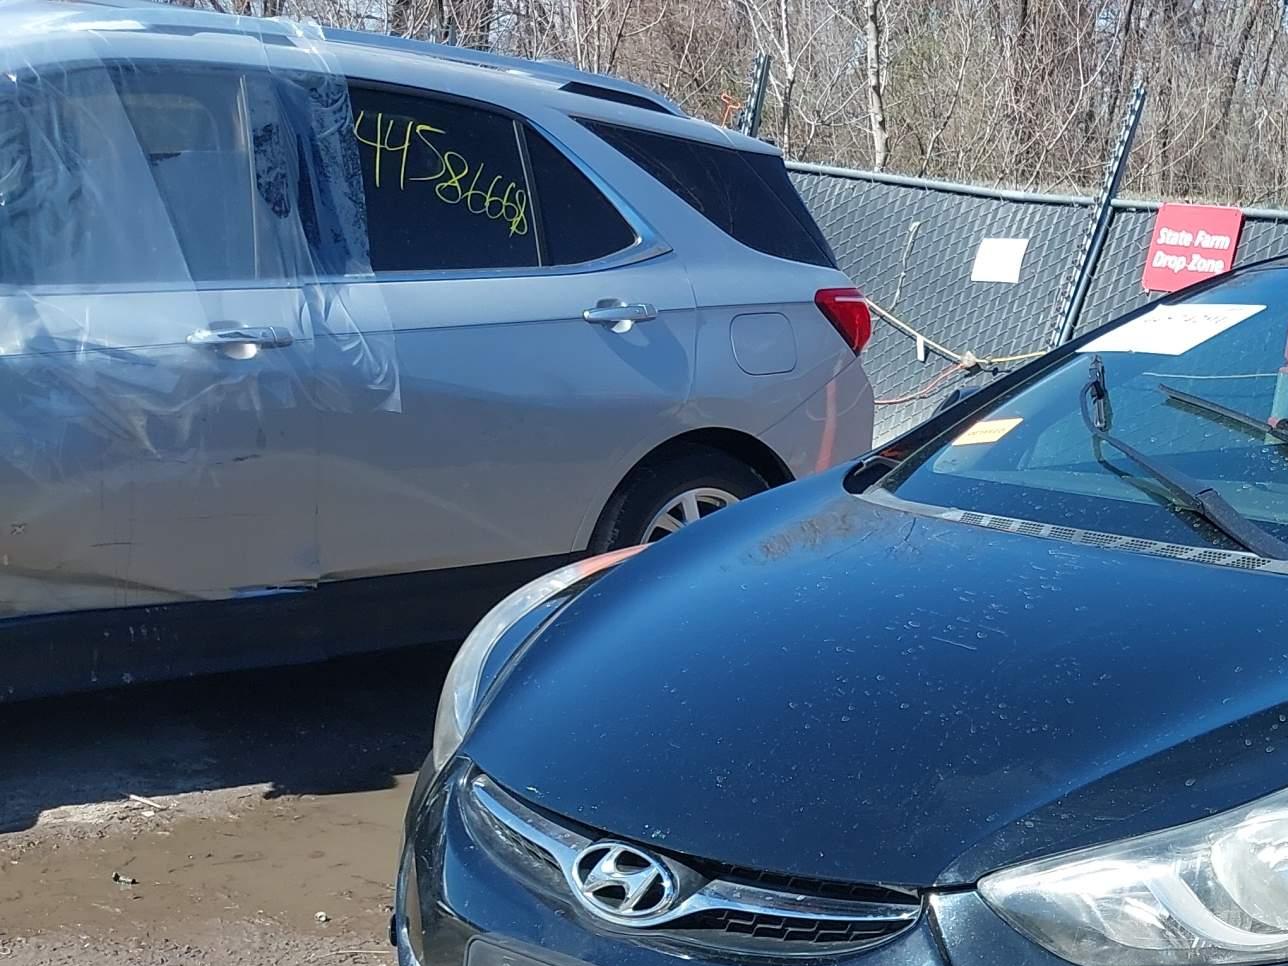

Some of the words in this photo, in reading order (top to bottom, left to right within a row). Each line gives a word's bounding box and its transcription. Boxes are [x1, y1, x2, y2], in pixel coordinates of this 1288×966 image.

[353, 110, 528, 239] 44586668
[1157, 227, 1193, 247] State
[1194, 230, 1231, 250] Farm
[1152, 250, 1187, 273] Drop
[1187, 253, 1225, 274] Zone
